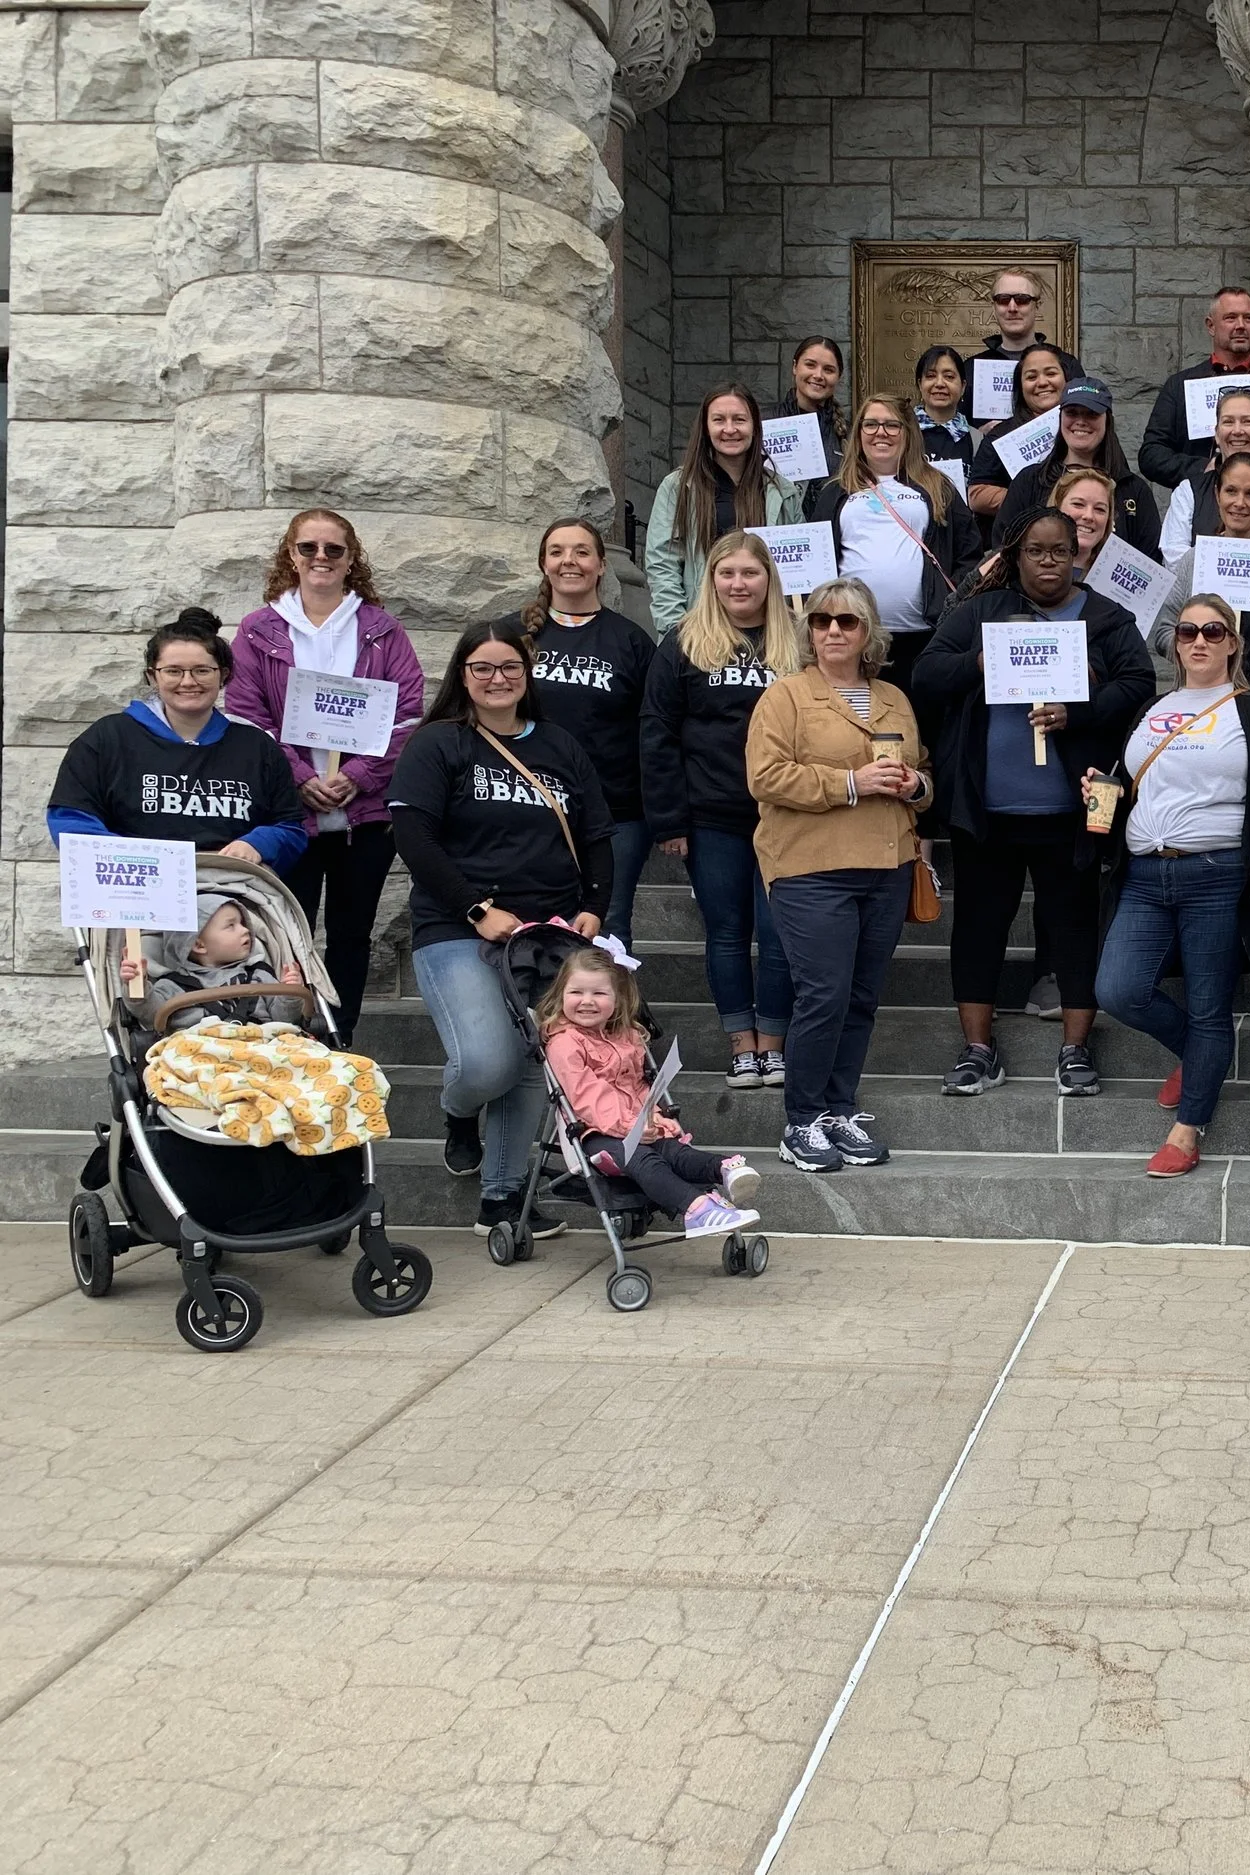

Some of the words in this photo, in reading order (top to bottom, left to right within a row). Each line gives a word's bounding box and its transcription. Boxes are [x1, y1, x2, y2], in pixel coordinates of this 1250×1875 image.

[900, 309, 956, 326] CITY
[968, 309, 999, 326] HA
[1019, 432, 1054, 456] DIAPER
[769, 544, 811, 555] DIAPER
[1114, 564, 1149, 590] DIAPER
[1217, 567, 1250, 578] WALK
[1110, 572, 1138, 594] WALK
[1009, 645, 1058, 656] DIAPER
[1009, 656, 1049, 666] WALK
[532, 664, 614, 692] BANK
[724, 667, 778, 688] BAN
[315, 692, 367, 709] DIAPER
[314, 702, 355, 717] WALK
[142, 774, 158, 813] CNY
[161, 792, 252, 822] BANK
[94, 854, 113, 862] THE
[114, 855, 159, 864] DOWNTOWN
[95, 862, 160, 876] DIAPER
[96, 874, 146, 887] WALK
